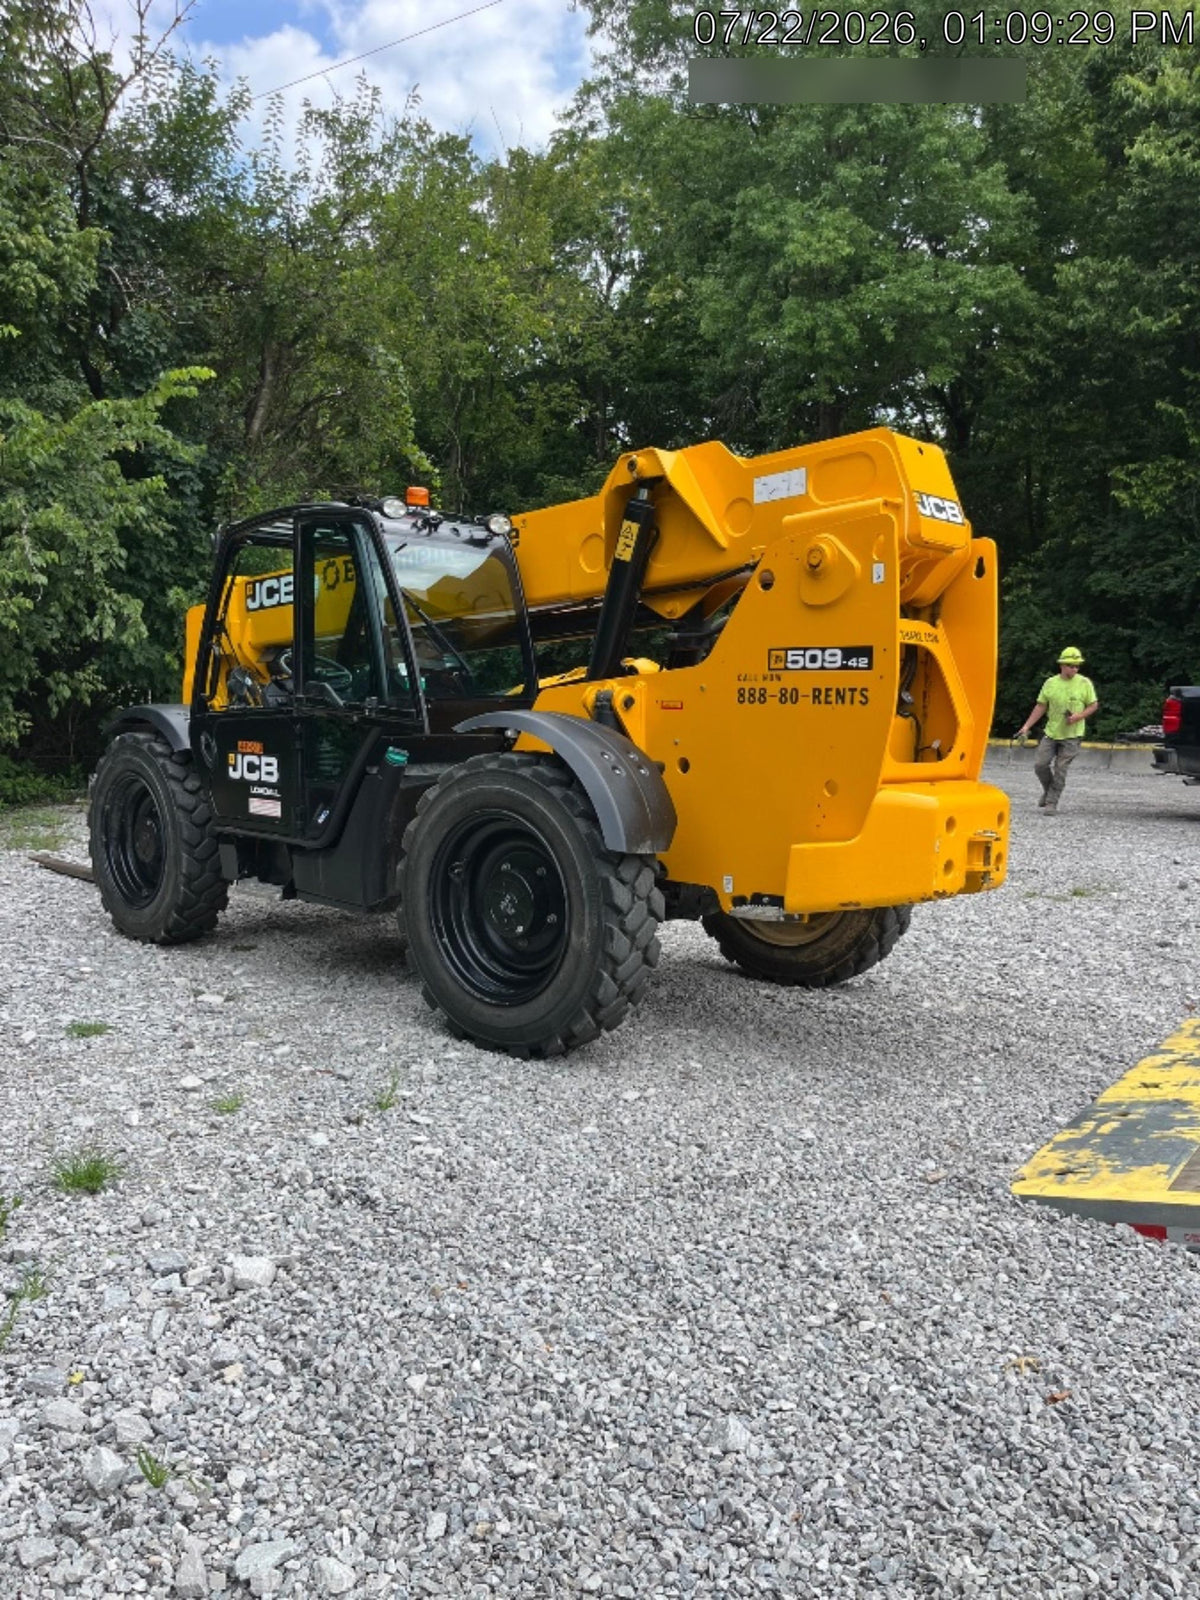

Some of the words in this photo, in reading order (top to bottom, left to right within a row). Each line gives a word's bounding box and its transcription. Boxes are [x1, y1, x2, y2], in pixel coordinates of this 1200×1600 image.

[916, 493, 963, 523] JCB
[786, 648, 869, 669] 509-42
[737, 687, 869, 705] 888-80-RENTS
[228, 753, 279, 782] JCB
